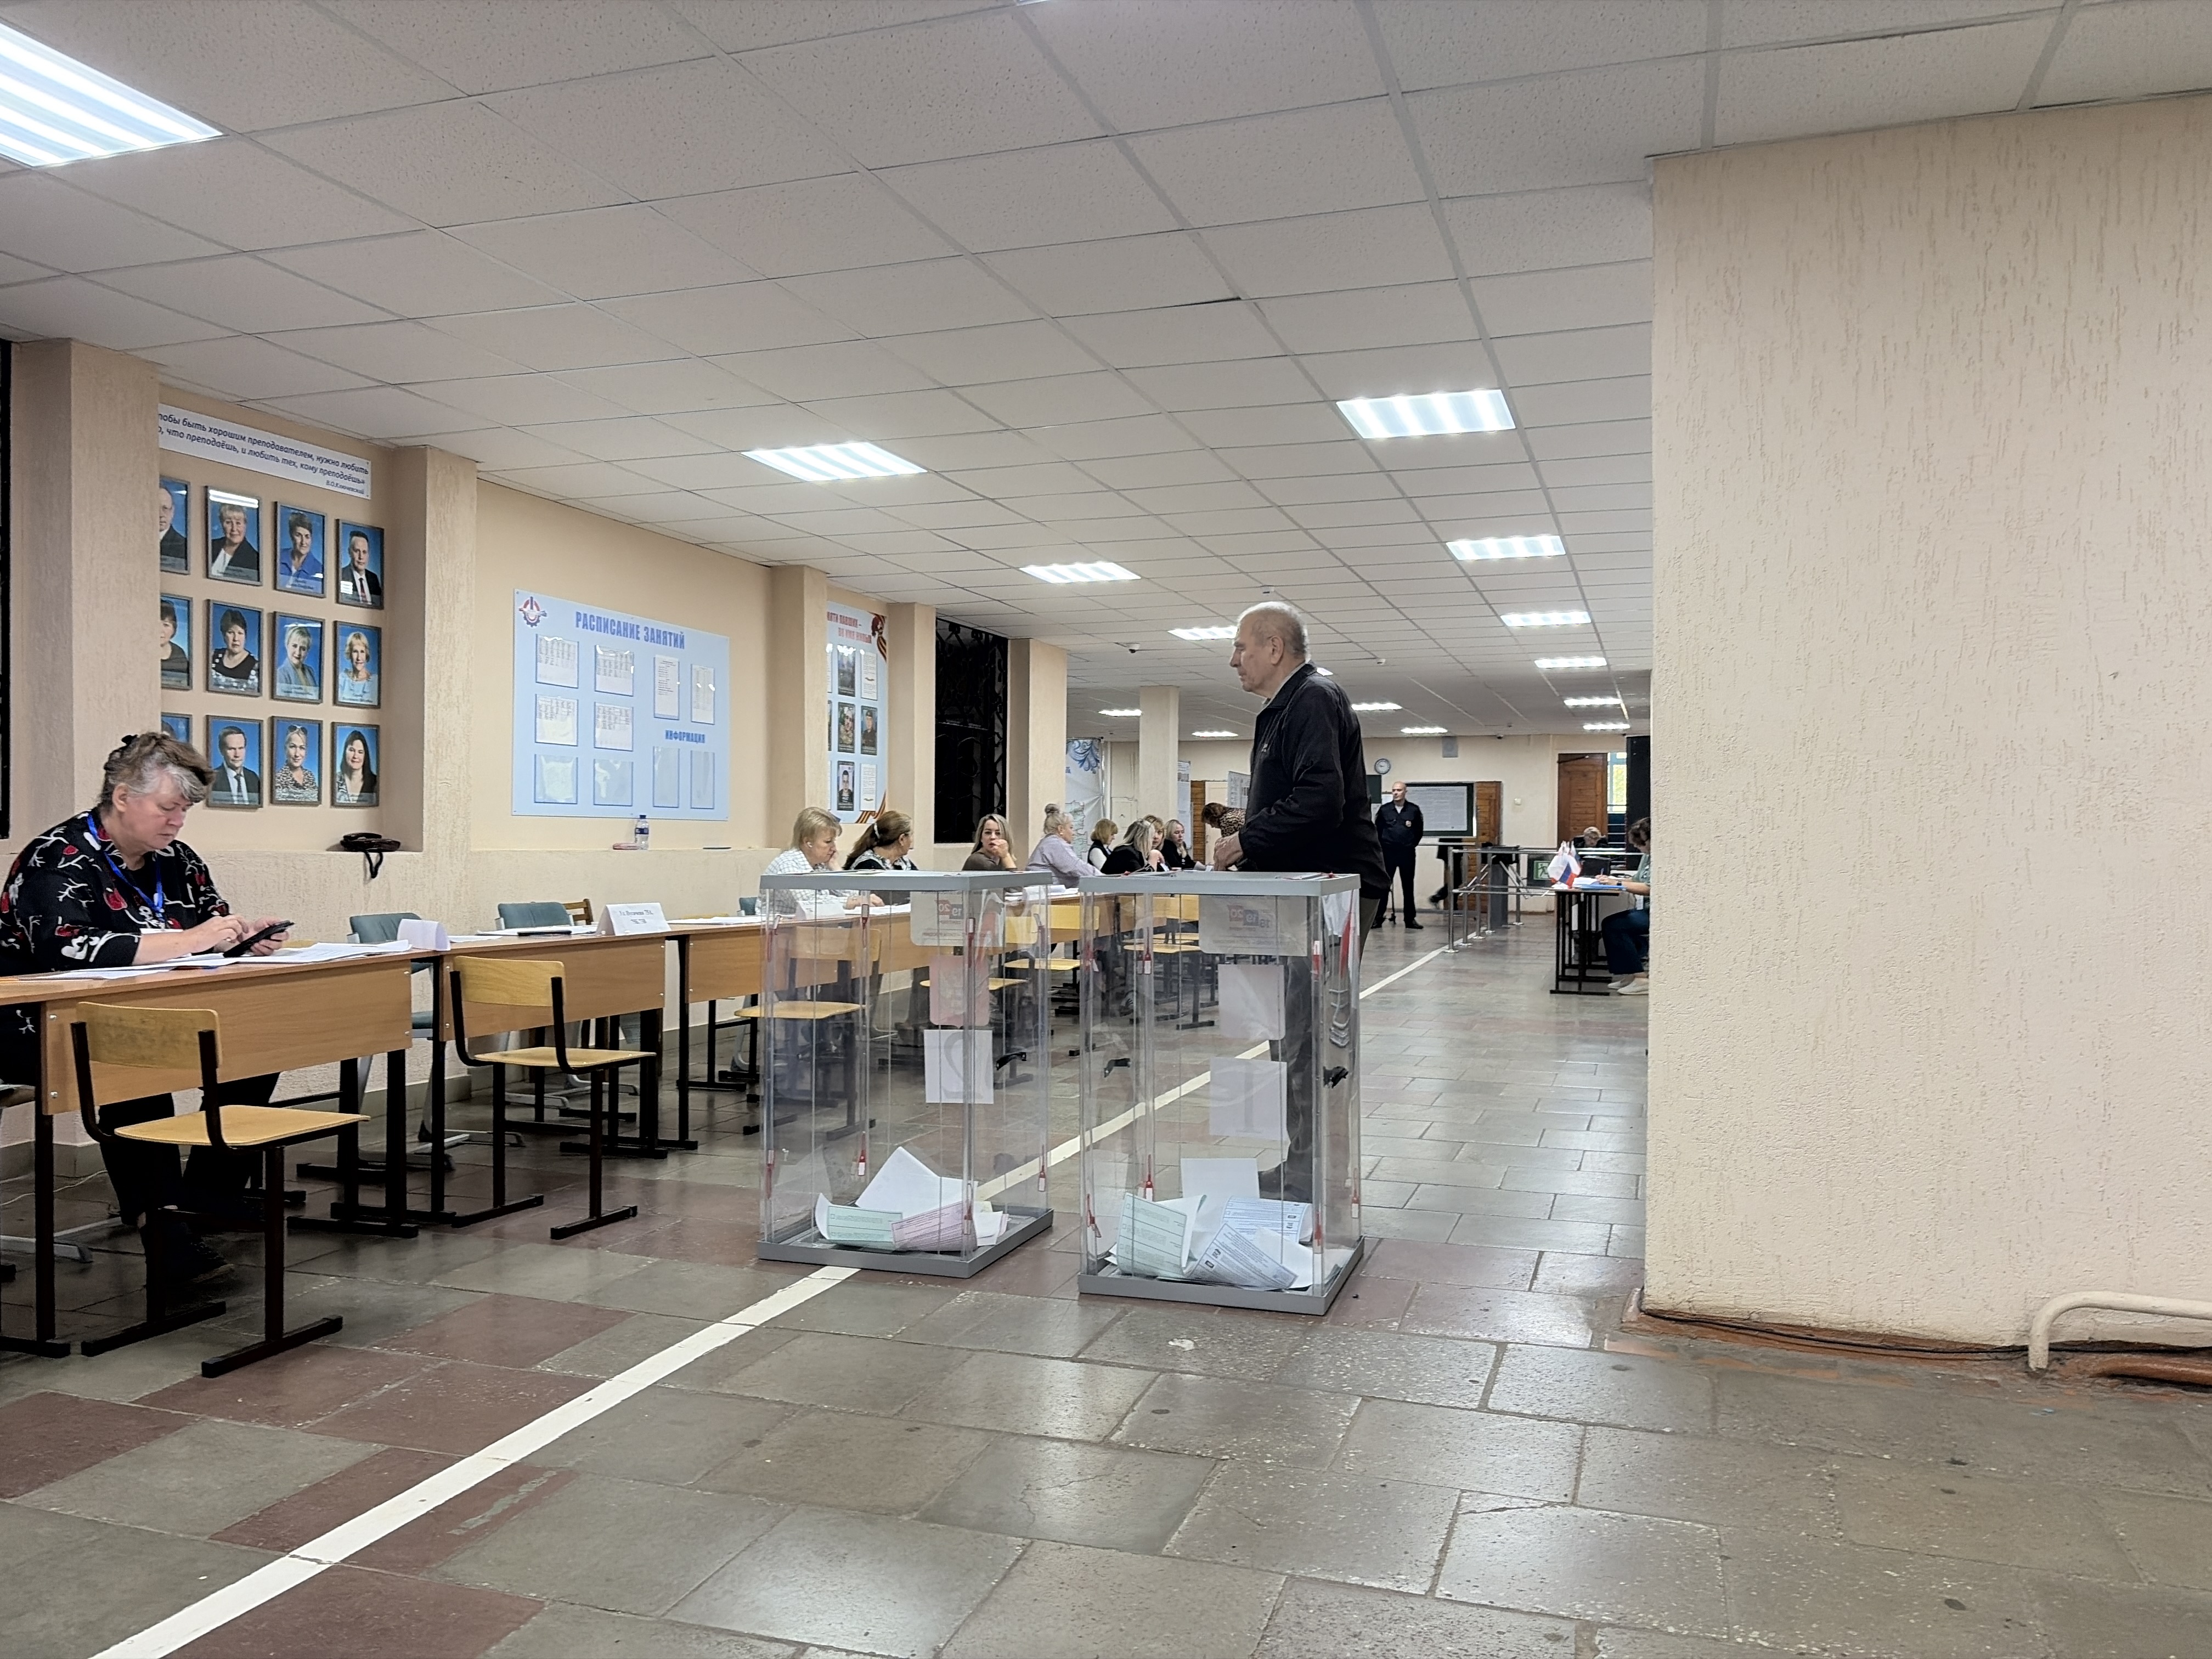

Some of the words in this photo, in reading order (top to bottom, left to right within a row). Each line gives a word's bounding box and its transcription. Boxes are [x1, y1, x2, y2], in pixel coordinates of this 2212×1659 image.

[166, 428, 184, 438] что
[186, 433, 239, 454] преподаёшь,
[247, 449, 280, 462] любить
[281, 458, 298, 469] тех,
[300, 462, 318, 474] кому
[182, 418, 207, 432] быть
[208, 426, 246, 442] хорошим
[247, 437, 315, 461] преподавателем,
[316, 455, 340, 467] нужно
[340, 462, 369, 475] любить
[575, 611, 640, 641] РАСПИСАНИЕ
[643, 625, 685, 650] ЗАНЯТИЙ
[665, 730, 705, 744] ИНФОРМАЦИЯ
